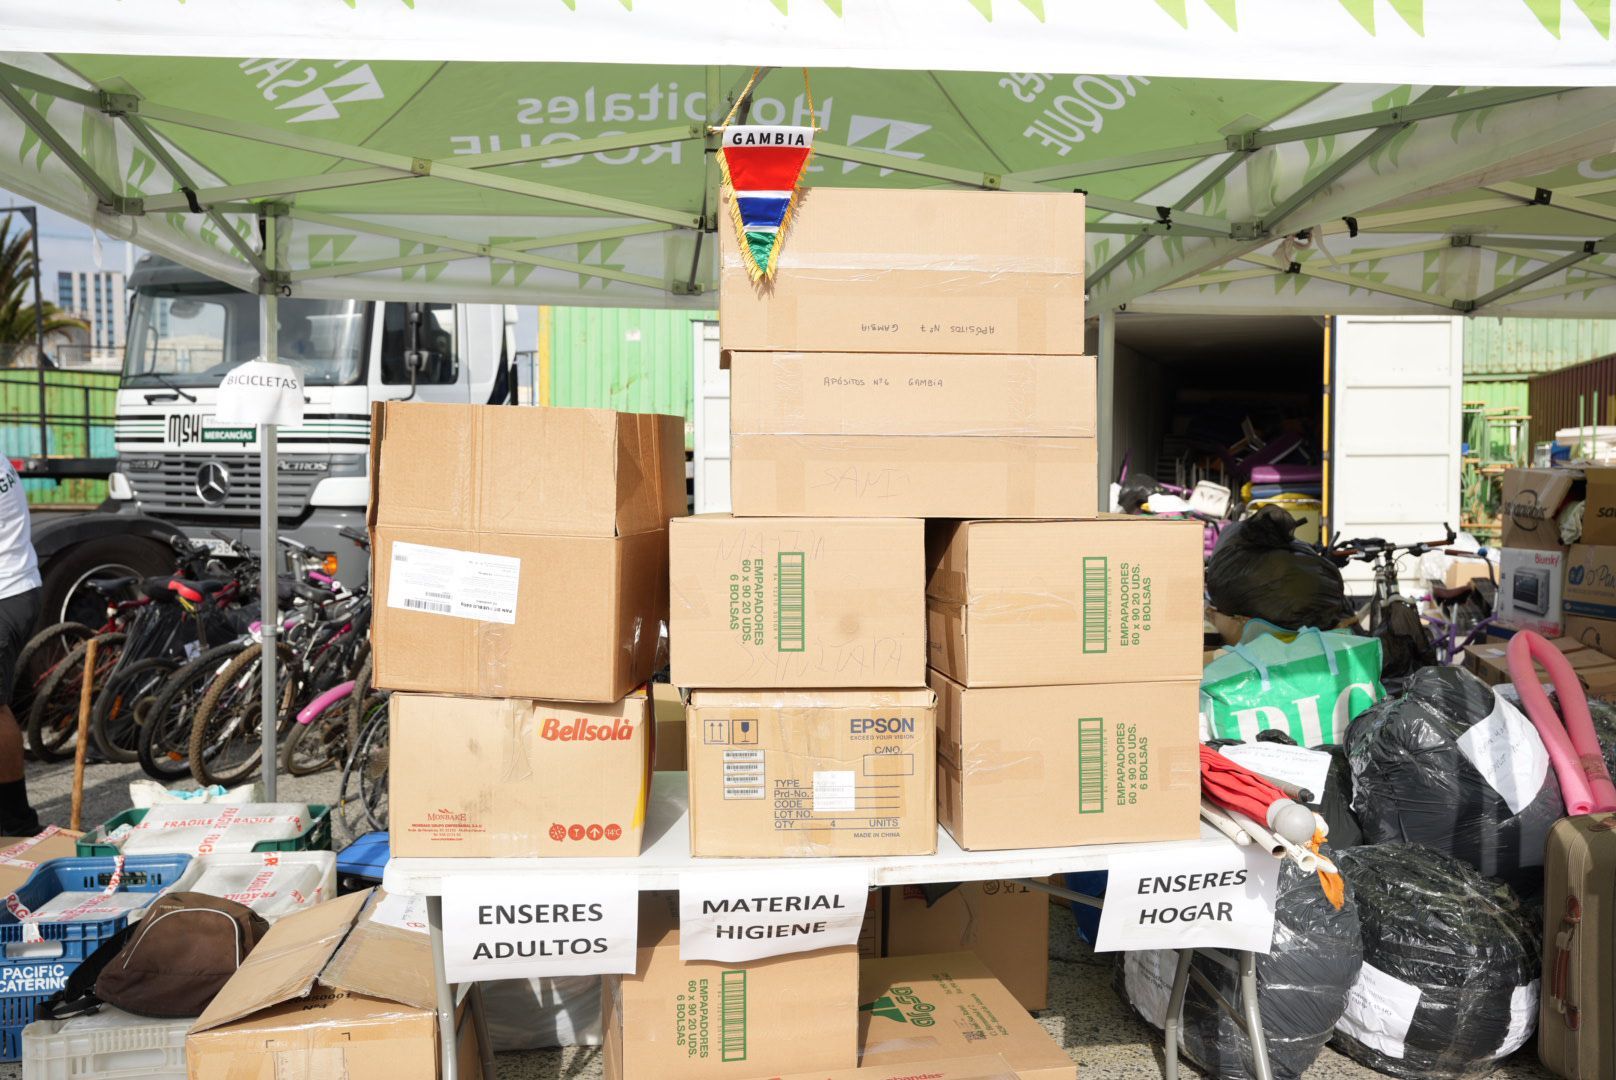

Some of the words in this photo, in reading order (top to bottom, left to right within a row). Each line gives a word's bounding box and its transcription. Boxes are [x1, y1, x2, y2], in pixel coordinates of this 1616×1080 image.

[732, 132, 805, 146] GAMBIA
[861, 323, 899, 333] GAMBIA
[226, 374, 298, 390] BICICLETAS
[204, 429, 254, 441] MERCANCÍAS
[742, 559, 752, 573] 60
[1131, 563, 1141, 590] UDS.
[742, 584, 752, 598] 90
[1131, 592, 1140, 605] 20
[1143, 577, 1151, 621] BOLSAS
[730, 584, 740, 630] BOLSAS
[742, 600, 752, 615] 20
[754, 558, 764, 646] EMPAPADORES
[1120, 562, 1129, 647] EMPAPADORES
[1131, 608, 1140, 621] 90
[742, 617, 752, 645] UDS.
[1131, 632, 1140, 646] 60
[540, 717, 635, 742] Bellsolà
[850, 717, 915, 734] EPSON
[1128, 723, 1137, 750] UDS.
[874, 745, 903, 755] C/NO.
[1116, 722, 1126, 806] EMPAPADORES
[1128, 752, 1137, 765] 20
[1139, 736, 1148, 781] BOLSAS
[1128, 767, 1137, 781] 90
[774, 779, 800, 788] TYPE
[774, 789, 810, 798] Prd-No.
[1128, 791, 1137, 805] 60
[774, 800, 803, 809] CODE
[774, 810, 794, 819] LOT
[796, 809, 814, 819] NO.
[774, 819, 795, 829] QTY
[830, 819, 836, 828] 4
[869, 818, 899, 828] UNITS
[1137, 869, 1248, 895] ENSERES
[702, 894, 846, 915] MATERIAL
[478, 903, 603, 925] ENSERES
[1138, 901, 1233, 925] HOGAR
[716, 921, 828, 940] HIGIENE
[472, 937, 608, 960] ADULTOS
[2, 964, 65, 980] PACIFIC
[688, 980, 697, 992] 60
[688, 1003, 697, 1015] 90
[676, 1003, 685, 1046] BOLSAS
[688, 1018, 697, 1031] 20
[699, 978, 709, 1059] EMPAPADORES
[688, 1033, 697, 1058] UDS.
